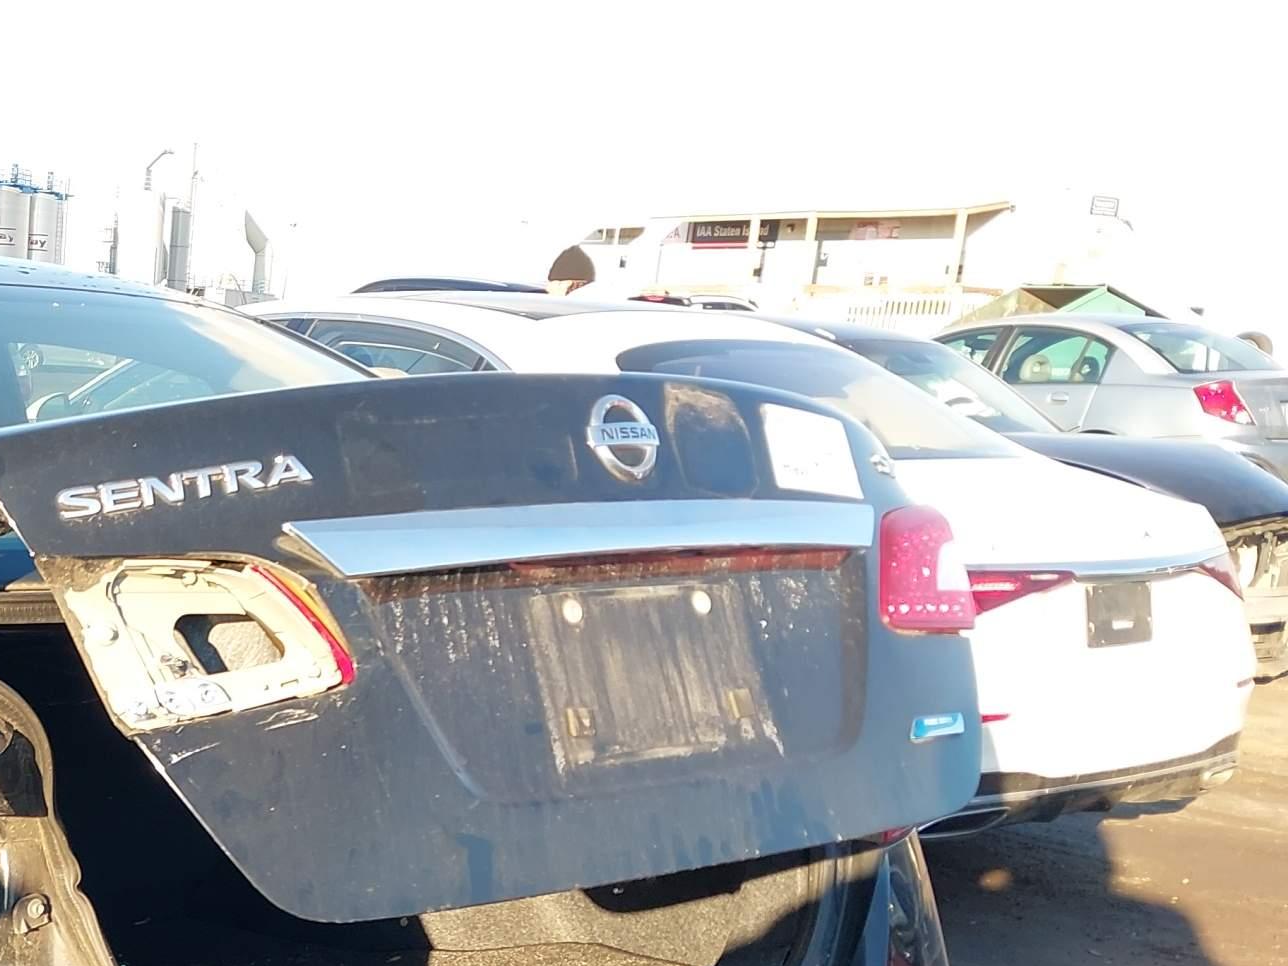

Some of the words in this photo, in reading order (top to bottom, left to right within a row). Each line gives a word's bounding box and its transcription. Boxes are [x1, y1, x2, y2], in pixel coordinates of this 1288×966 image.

[696, 225, 712, 237] IAA
[713, 224, 741, 237] Staten
[601, 426, 656, 441] NISSAN
[57, 455, 313, 519] SENTRA
